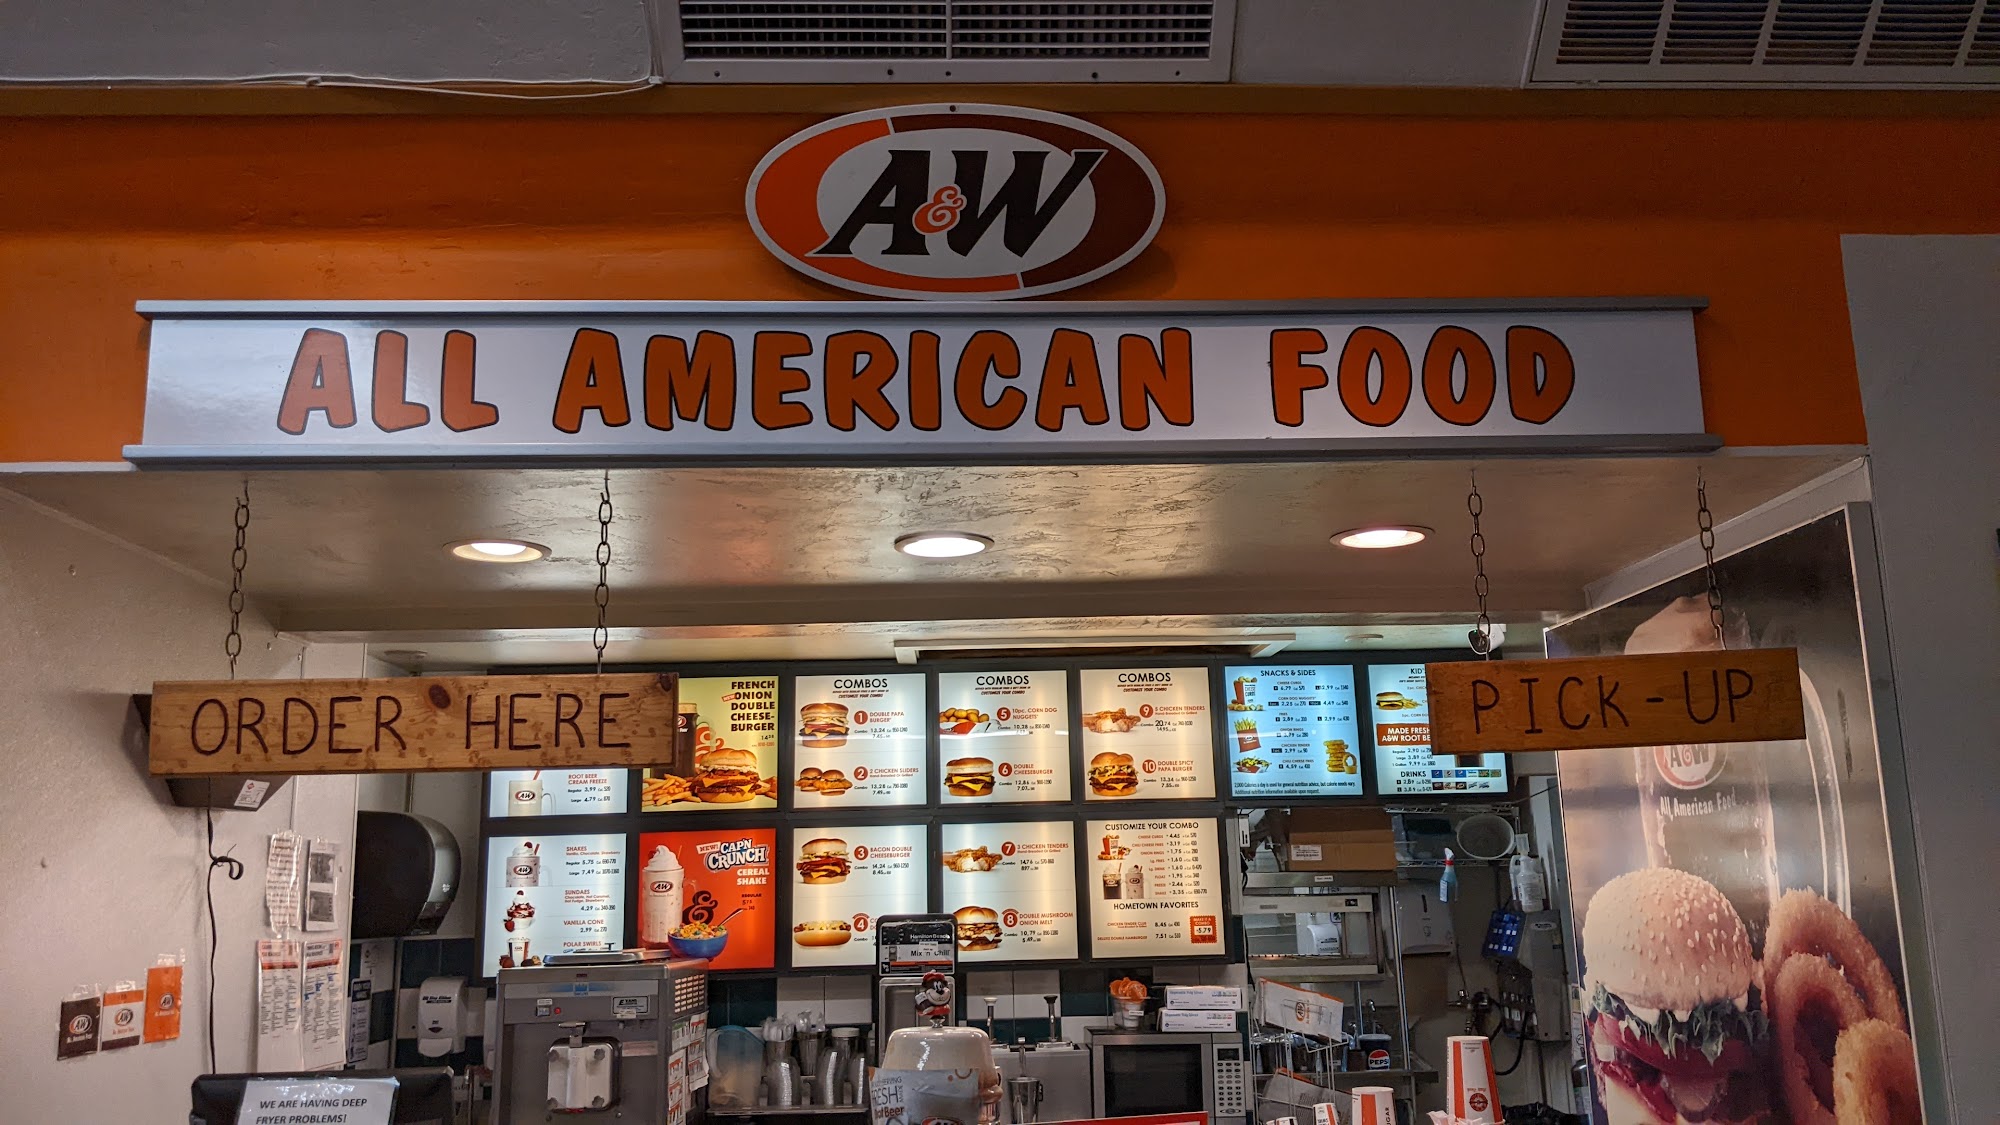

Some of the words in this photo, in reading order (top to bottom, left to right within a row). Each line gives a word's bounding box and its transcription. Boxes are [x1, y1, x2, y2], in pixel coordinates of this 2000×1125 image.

[805, 149, 1107, 258] A&W
[277, 328, 499, 435] ALL
[553, 327, 1195, 433] AMERICAN
[1270, 325, 1575, 427] FOOD
[976, 675, 1029, 686] COMBOS
[1118, 672, 1171, 682] COMBOS
[731, 681, 775, 690] FRENCH
[834, 678, 888, 688] COMBOS
[735, 691, 772, 700] ONION
[731, 702, 775, 710] DOUBLE
[731, 712, 775, 721] CHEESE-
[191, 695, 406, 756] ORDER
[465, 693, 630, 750] HERE
[731, 723, 775, 732] BURGER
[1674, 797, 1714, 817] American
[708, 847, 766, 869] CRUNCH
[737, 868, 770, 876] CEREAL
[737, 877, 767, 886] SHAKE
[1114, 902, 1158, 910] HOMETOWN
[1160, 901, 1199, 909] FAVORITES
[260, 1101, 276, 1109] WE
[278, 1100, 298, 1108] ARE
[300, 1099, 340, 1107] HAVING
[342, 1098, 367, 1107] DEEP
[256, 1116, 286, 1124] FRYER
[289, 1114, 347, 1124] PROBLEMS!
